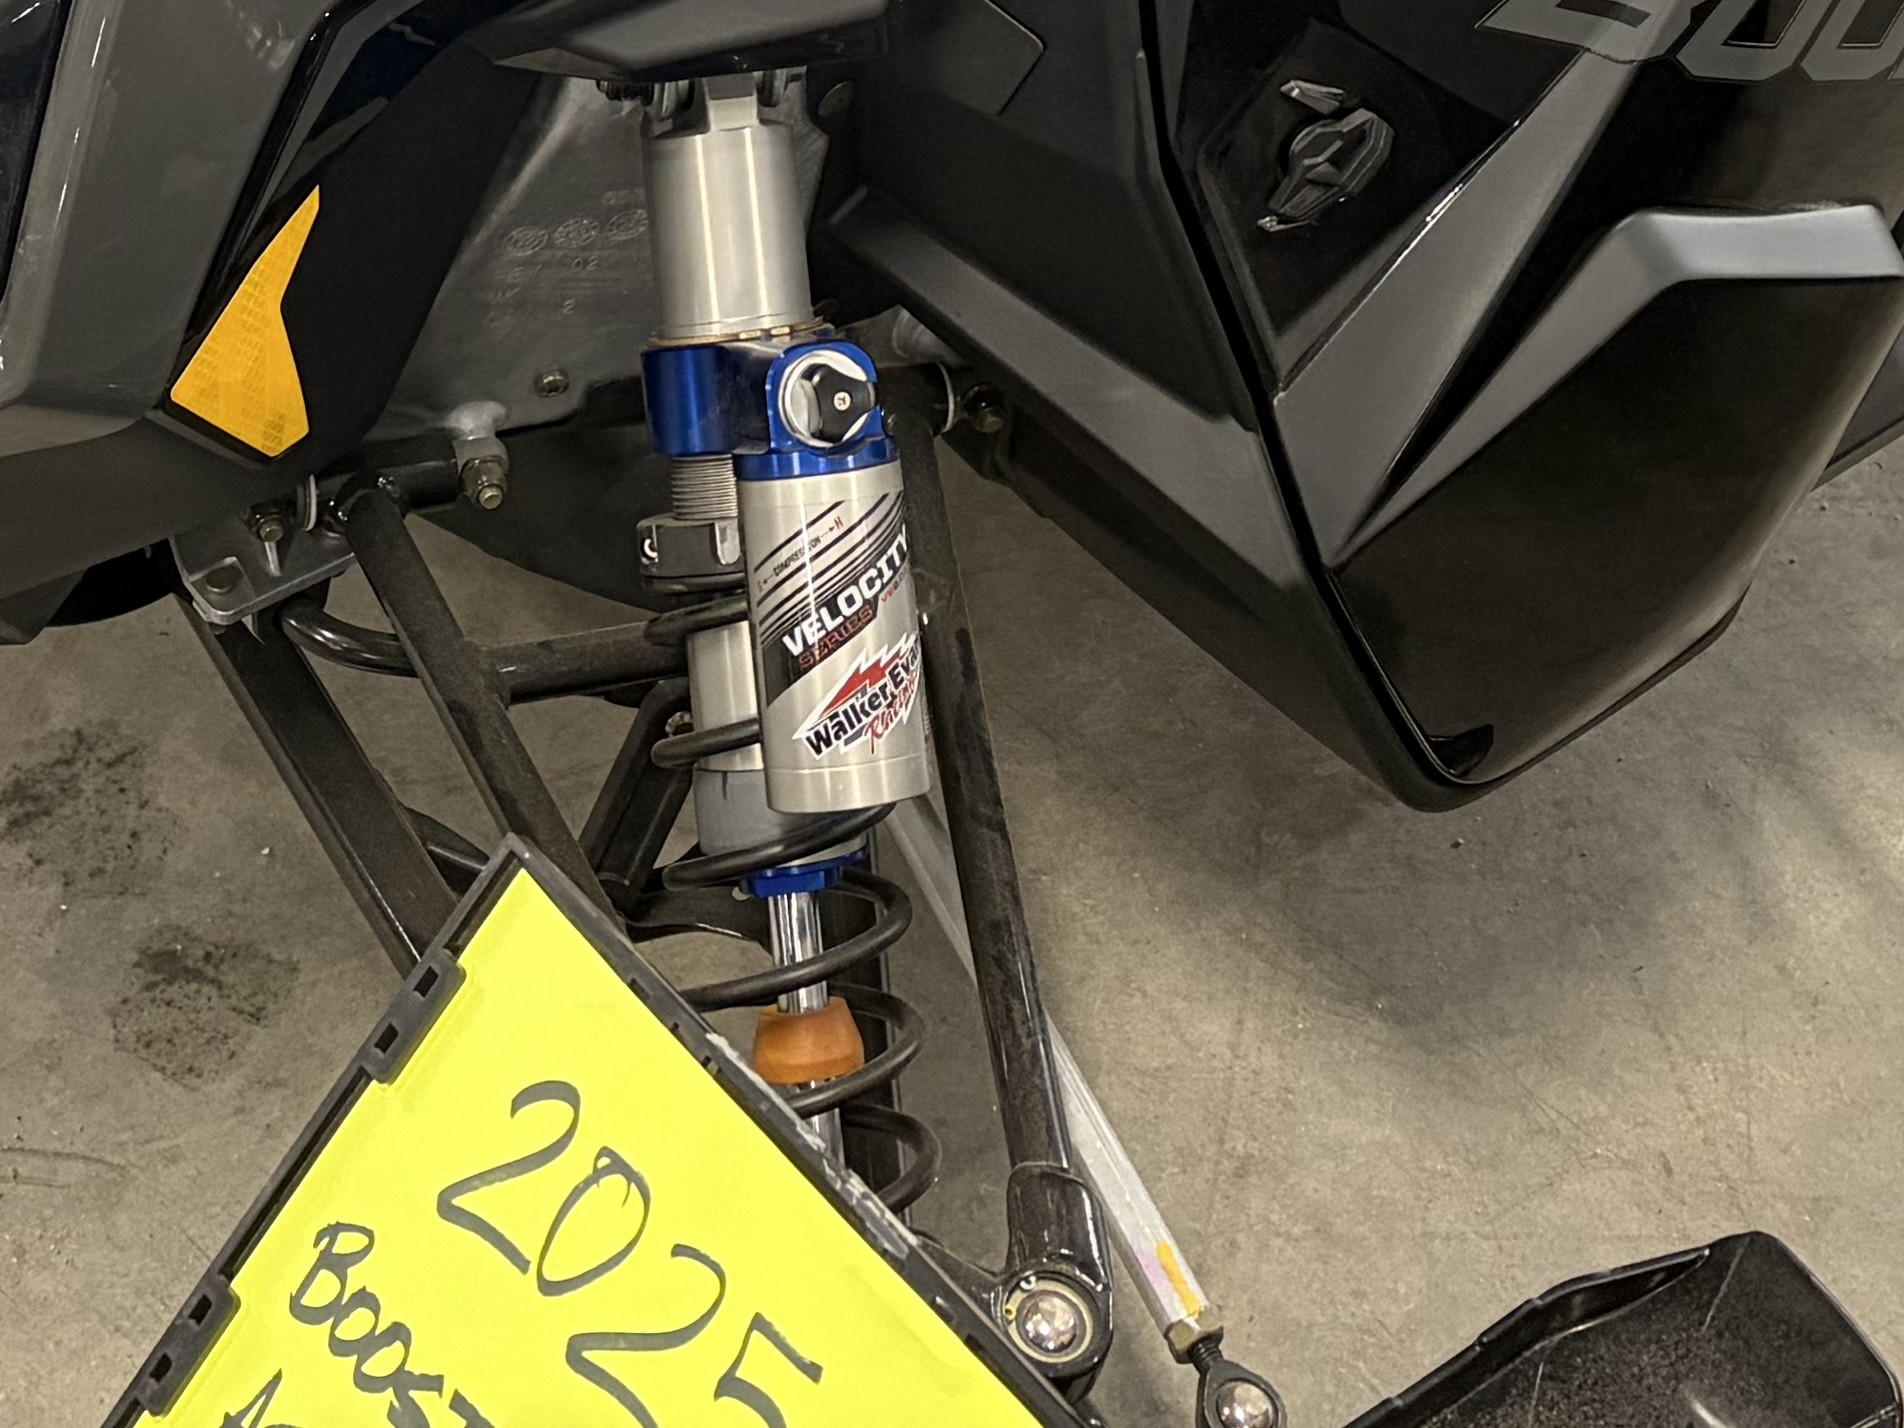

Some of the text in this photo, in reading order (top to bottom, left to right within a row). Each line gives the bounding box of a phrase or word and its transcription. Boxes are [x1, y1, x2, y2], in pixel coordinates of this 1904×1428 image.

[781, 522, 909, 658] VELOCITY
[798, 603, 874, 671] SERIES
[805, 678, 890, 759] Walker
[436, 1078, 824, 1428] 2025
